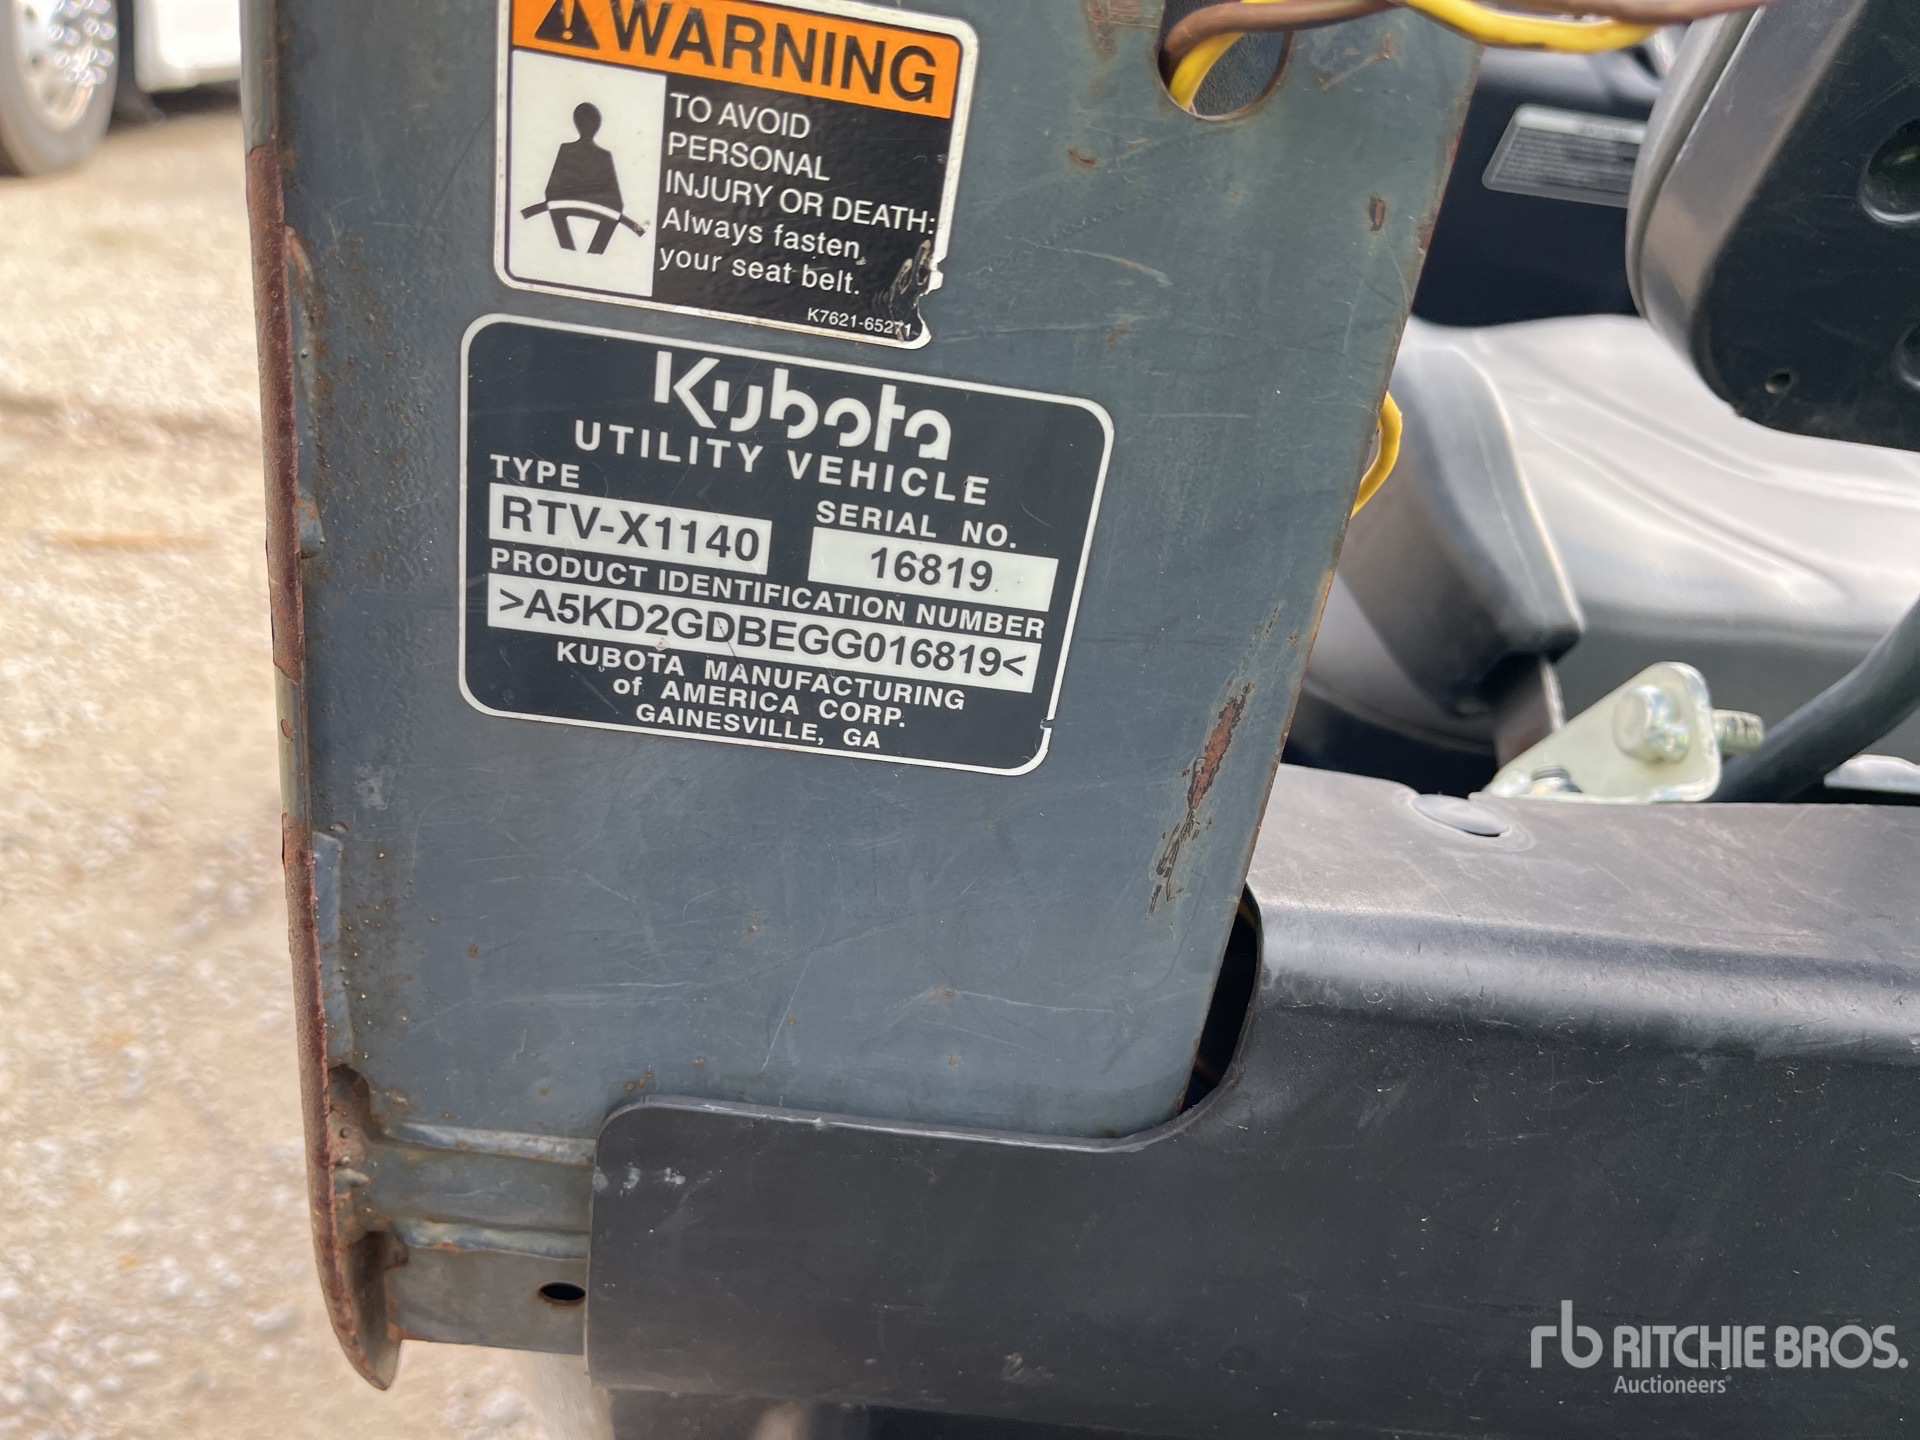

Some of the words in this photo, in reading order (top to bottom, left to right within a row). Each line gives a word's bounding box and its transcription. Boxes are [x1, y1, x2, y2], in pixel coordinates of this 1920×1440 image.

[609, 0, 936, 103] WARNING
[670, 92, 713, 124] TO
[717, 102, 811, 139] AVOID
[668, 133, 830, 181] PERSONAL
[661, 208, 764, 245] Always
[665, 170, 774, 208] INJURY
[779, 189, 825, 216] OR
[831, 197, 936, 235] DEATH:
[659, 248, 724, 275] your
[731, 258, 794, 285] seat
[801, 266, 861, 296] belt.
[807, 308, 912, 336] K7621-65271
[654, 351, 952, 461] Kubota
[490, 454, 580, 489] TYPE
[574, 420, 763, 473] UTILITY
[788, 451, 990, 506] VEHICLE
[502, 494, 760, 562] RTV-X1140
[816, 501, 937, 540] SERIAL
[961, 520, 1017, 548] NO.
[490, 547, 648, 588] PRODUCT
[658, 570, 905, 621] IDENTIFICATION
[916, 605, 1044, 639] NUMBER
[870, 547, 993, 592] 16819
[556, 642, 685, 676] KUBOTA
[704, 662, 966, 711] MANUFACTURING
[613, 676, 642, 697] of
[660, 680, 802, 716] AMERICA
[818, 699, 907, 729] CORP.
[635, 704, 824, 744] GAINESVILLE,
[842, 729, 881, 750] GA
